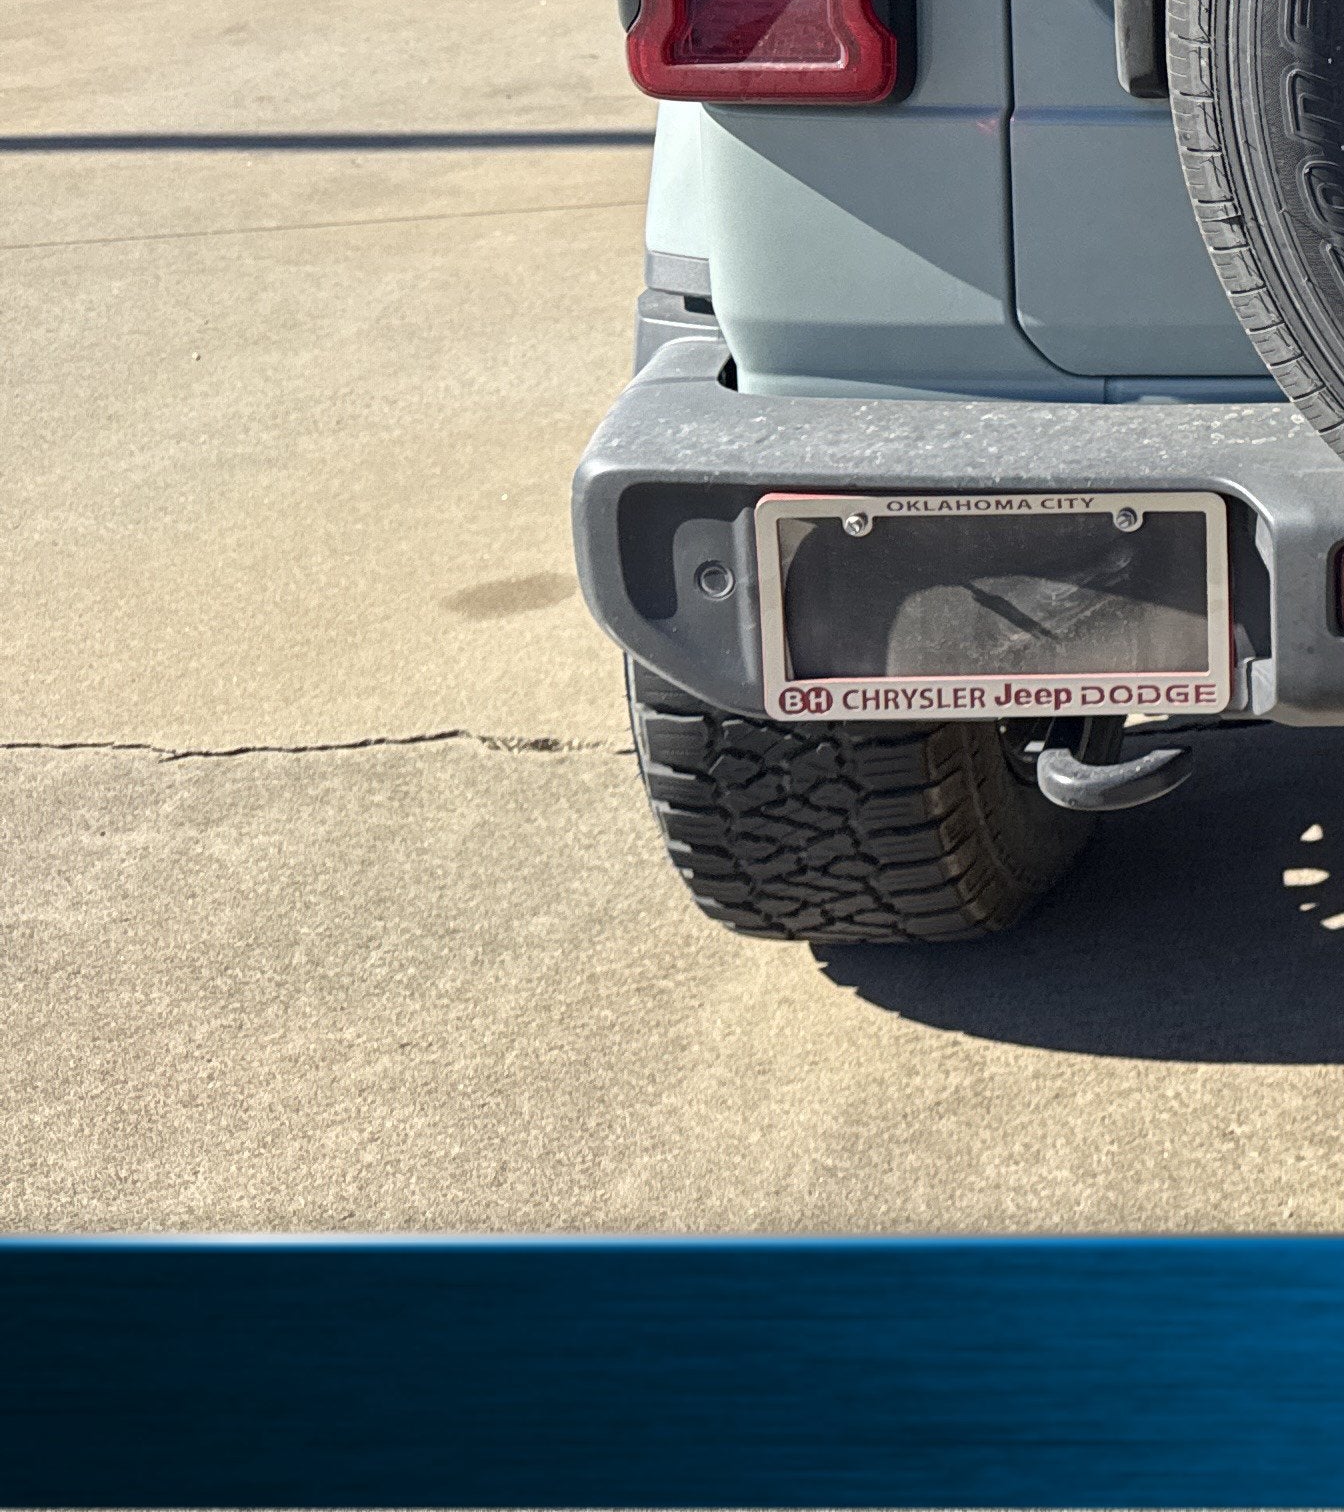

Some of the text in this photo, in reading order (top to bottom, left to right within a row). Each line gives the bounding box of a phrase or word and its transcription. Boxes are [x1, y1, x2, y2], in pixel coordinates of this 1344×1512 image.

[887, 496, 1095, 512] OKLAHOMA CITY
[779, 682, 1217, 715] BH CHRYSLER Jeep DODGE
